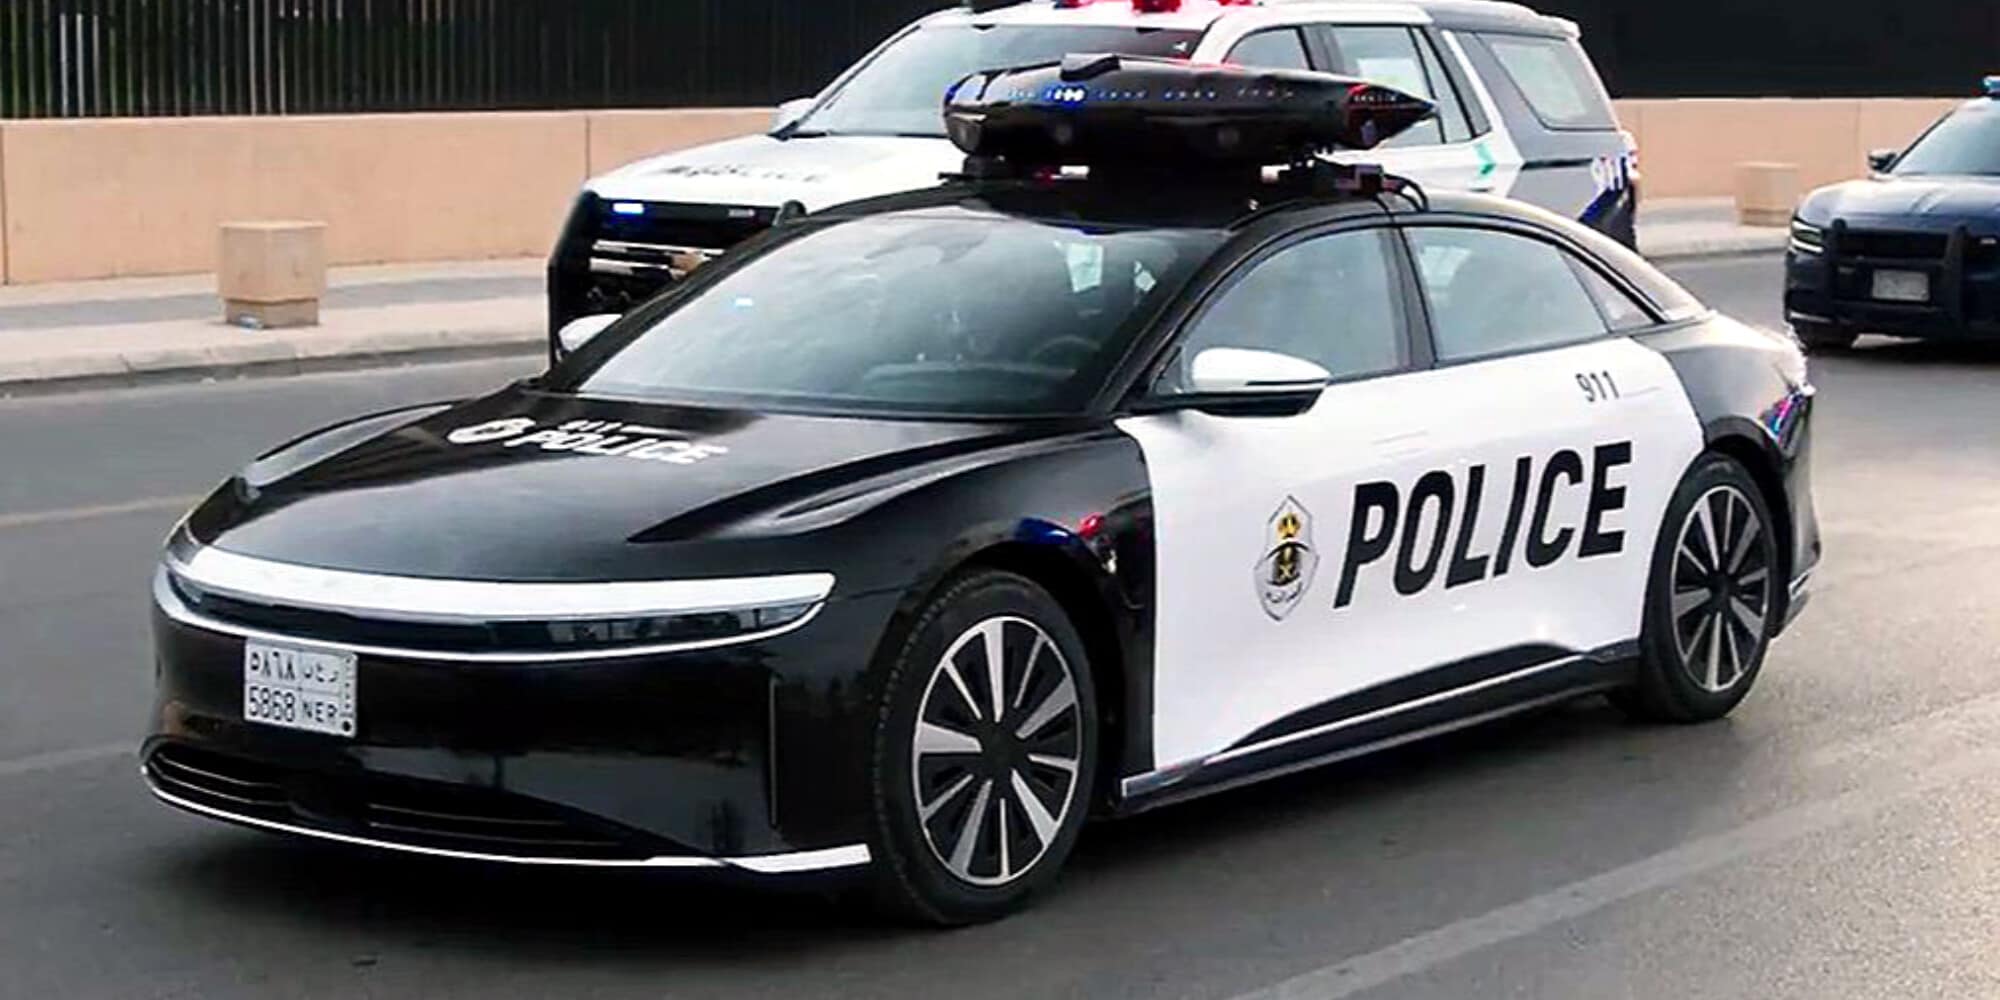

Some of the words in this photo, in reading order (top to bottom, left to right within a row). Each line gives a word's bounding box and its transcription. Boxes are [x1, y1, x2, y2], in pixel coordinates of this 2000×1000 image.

[1575, 370, 1620, 402] 911
[503, 429, 730, 465] POLICE
[1333, 440, 1633, 609] POLICE
[249, 686, 296, 722] 5868
[302, 701, 339, 725] NER
